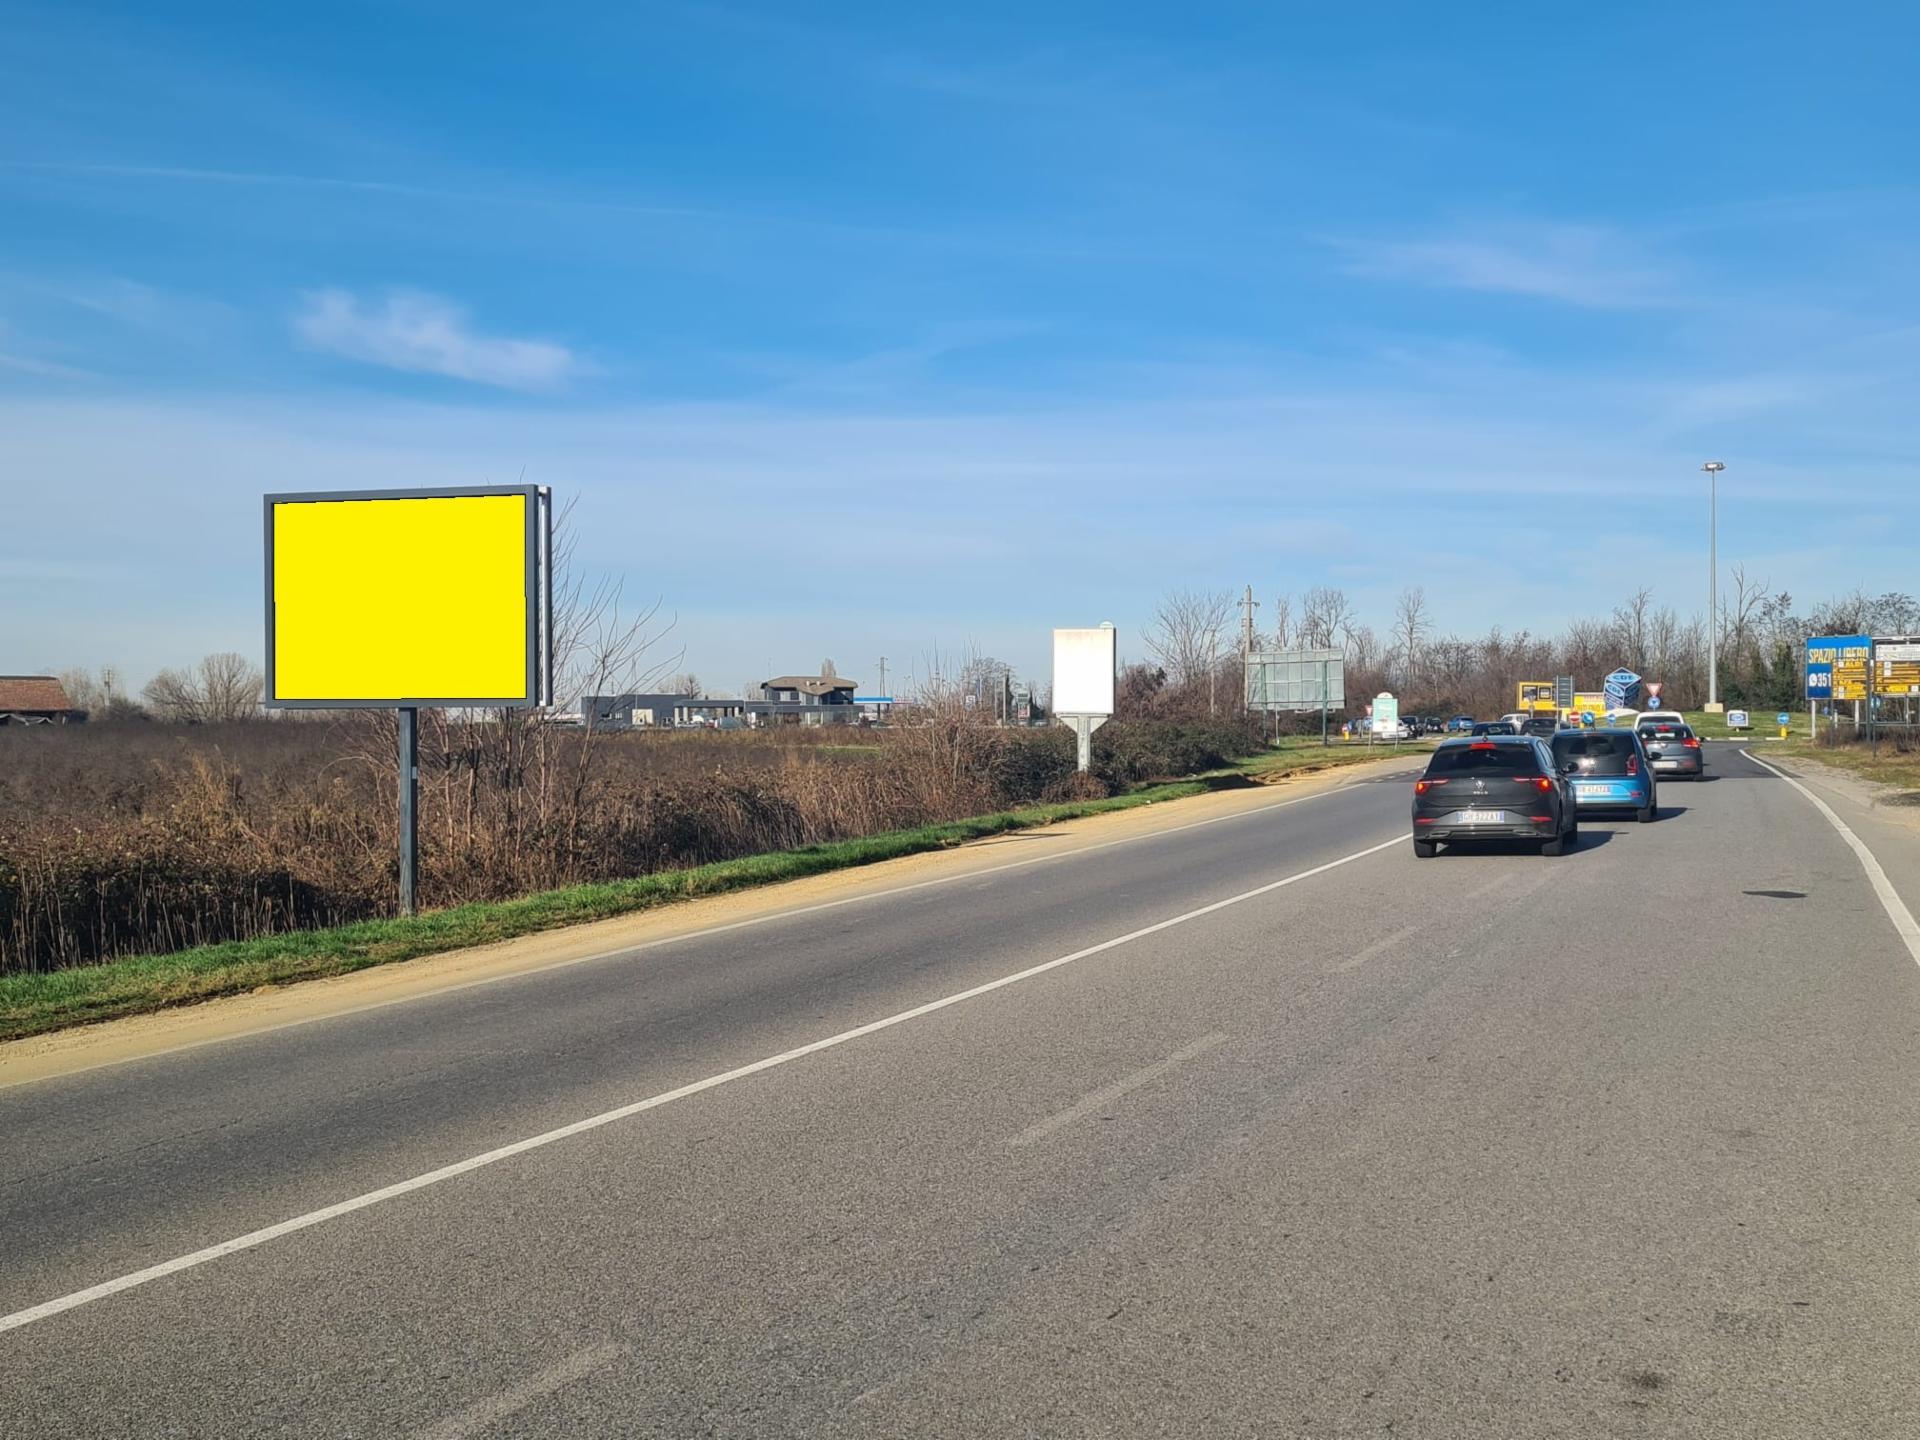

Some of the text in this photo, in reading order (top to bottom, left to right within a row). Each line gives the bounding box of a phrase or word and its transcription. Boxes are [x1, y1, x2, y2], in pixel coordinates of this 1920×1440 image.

[1809, 648, 1836, 663] SPAZIO
[1839, 646, 1868, 661] LIBERO
[1817, 673, 1831, 687] 351
